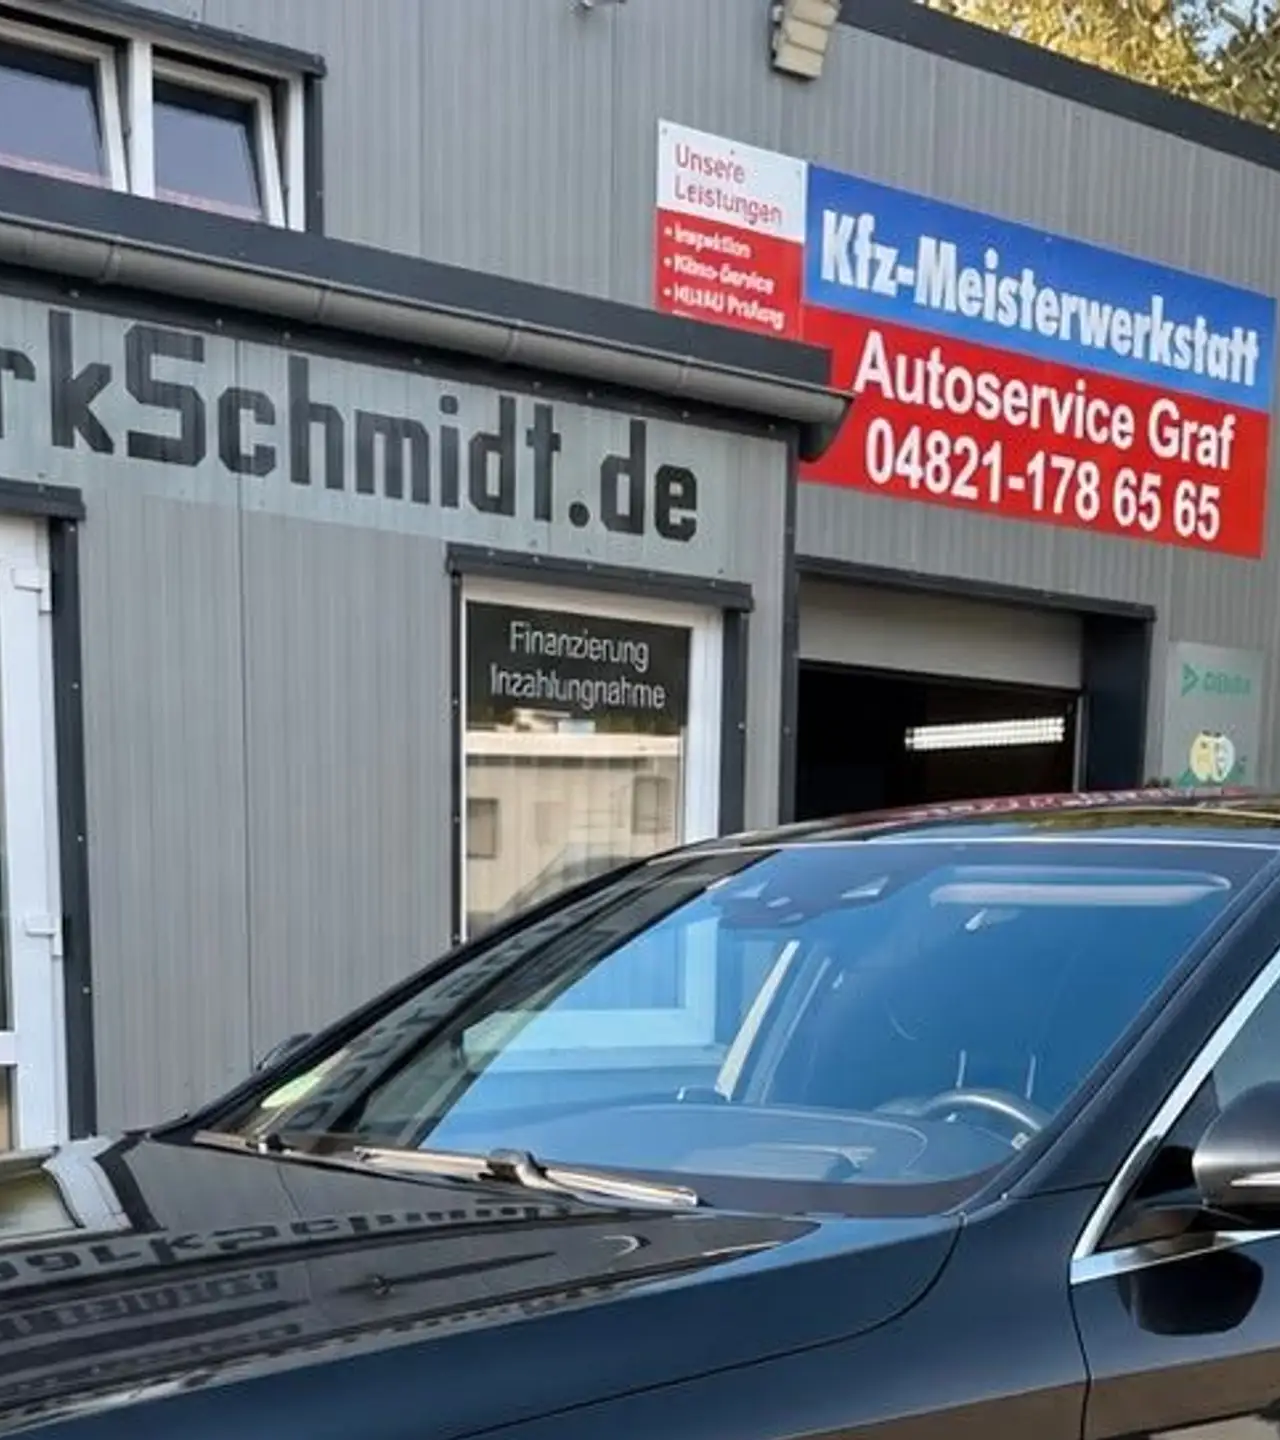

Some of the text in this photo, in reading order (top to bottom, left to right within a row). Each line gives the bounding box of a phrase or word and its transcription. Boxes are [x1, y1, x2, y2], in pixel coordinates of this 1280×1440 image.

[675, 143, 745, 184] Unsere
[674, 175, 782, 226] Leistungen
[821, 208, 1259, 387] Kfz-Meisterwerkstatt
[853, 330, 1236, 470] Autoservice Graf
[865, 416, 1221, 542] 04821-178 65 65
[510, 620, 650, 673] Finanzierung
[490, 663, 666, 711] Inzahlungnahme
